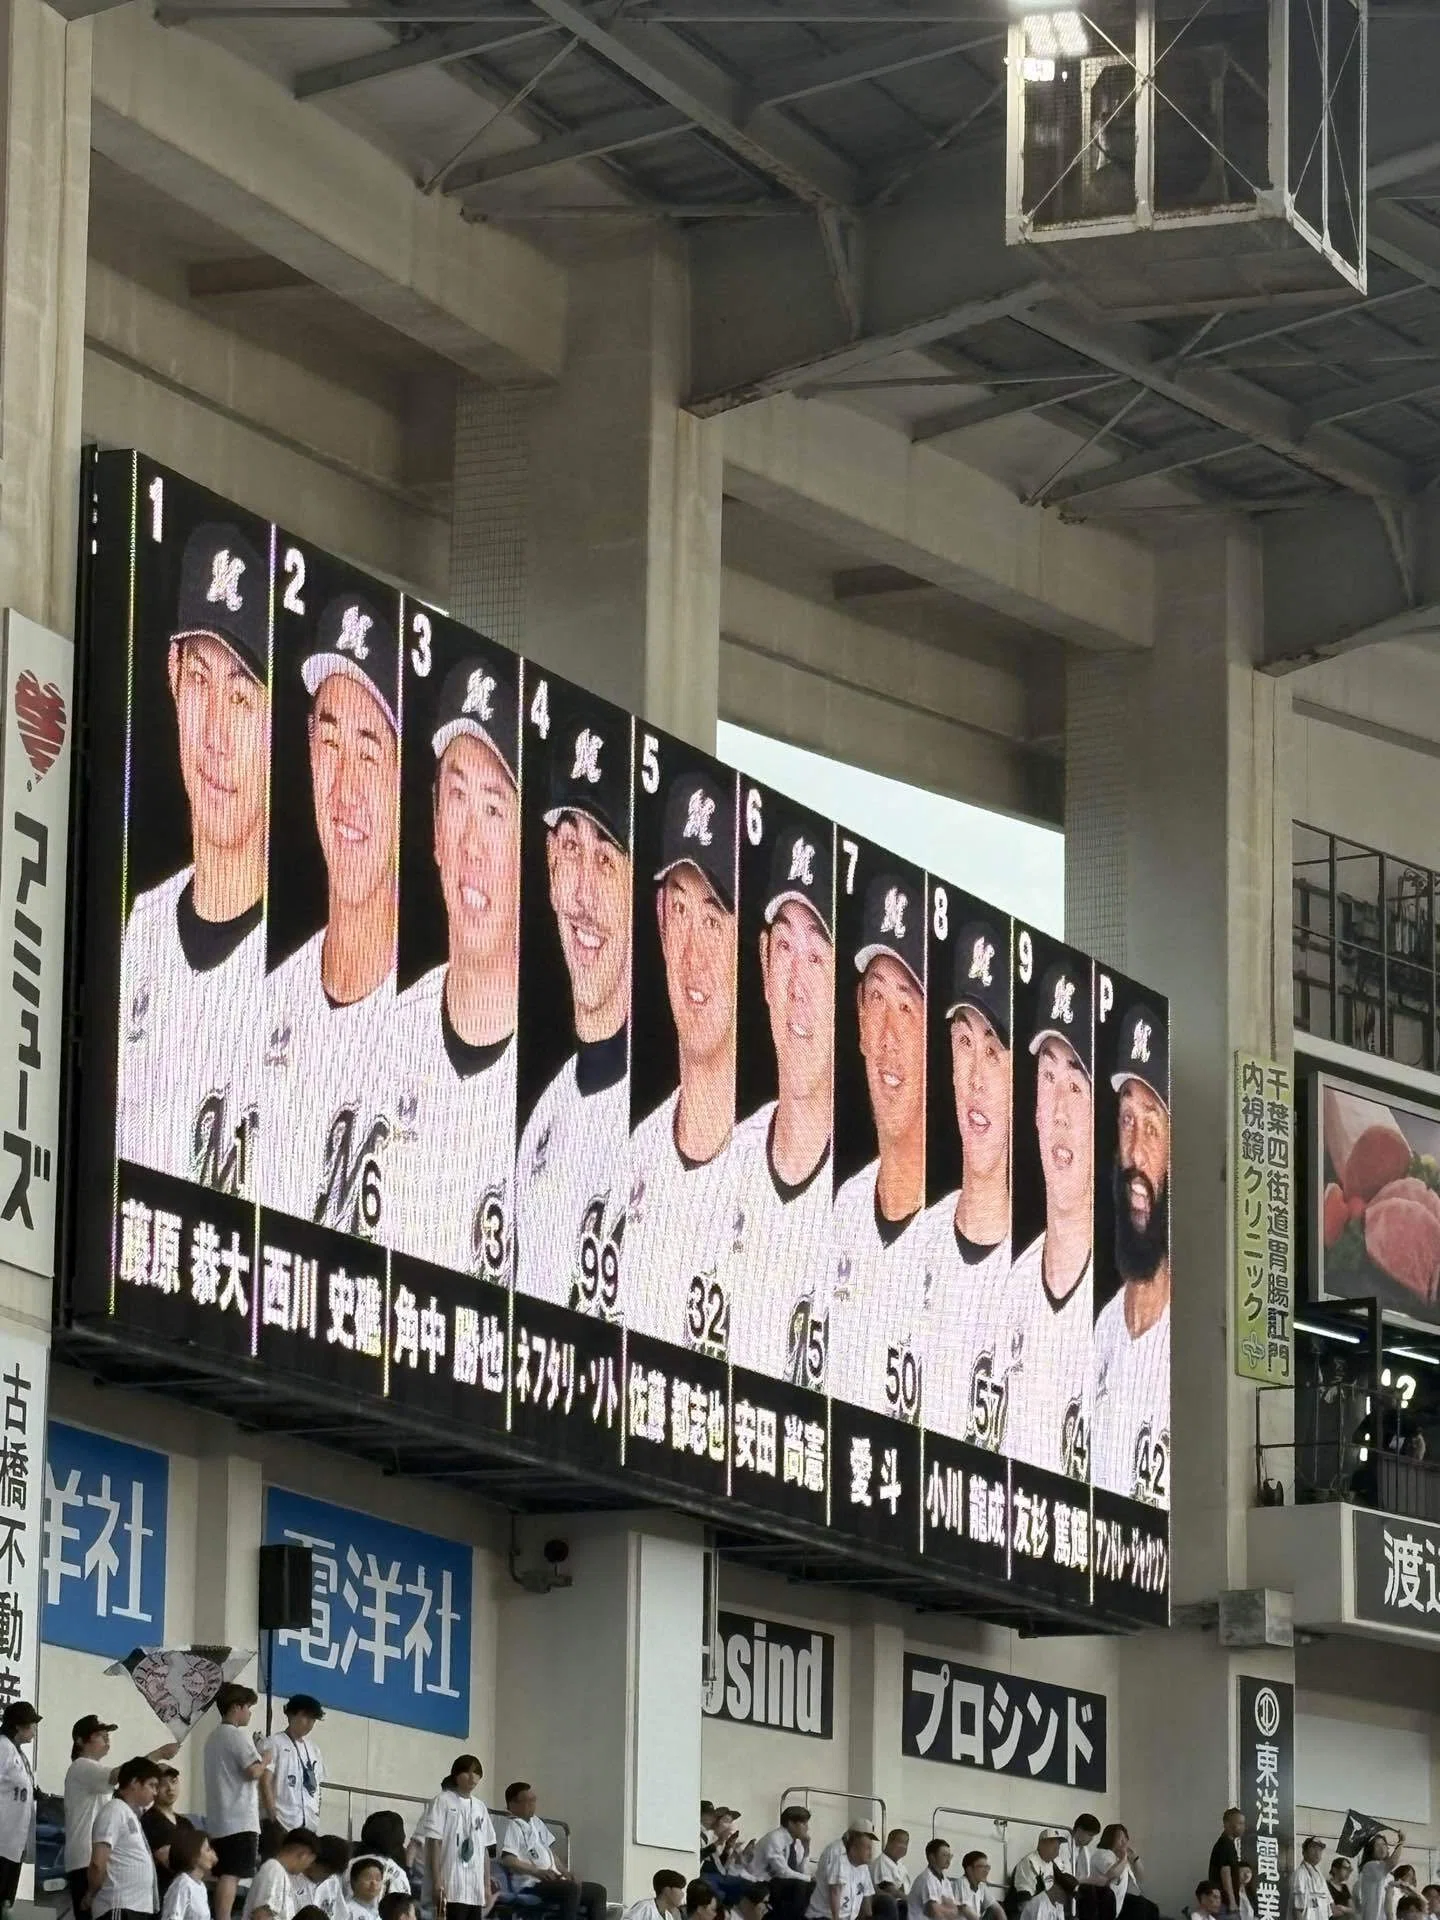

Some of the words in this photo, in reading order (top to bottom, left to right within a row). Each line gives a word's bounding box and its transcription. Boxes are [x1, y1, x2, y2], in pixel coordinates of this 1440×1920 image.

[149, 476, 163, 543] 1
[283, 548, 306, 616] 2
[411, 613, 432, 678] 3
[531, 679, 551, 740] 4
[641, 734, 660, 794] 5
[746, 788, 763, 846] 6
[842, 839, 858, 894] 7
[934, 887, 948, 941] 8
[1018, 931, 1033, 984] 9
[1100, 974, 1114, 1023] P
[361, 1159, 382, 1227] 6
[1242, 1061, 1265, 1322] 内視鏡クリニック
[1266, 1067, 1290, 1377] 千葉四街道胃腸肛門
[484, 1203, 504, 1269] 3
[263, 1245, 319, 1339] 西川
[580, 1236, 618, 1307] 99
[394, 1284, 446, 1374] 角中
[688, 1275, 725, 1344] 32
[808, 1317, 824, 1378] 5
[886, 1346, 917, 1409] 50
[735, 1399, 777, 1477] 安田
[975, 1378, 1004, 1438] 57
[927, 1460, 963, 1535] 小川
[1138, 1438, 1165, 1496] 42
[1013, 1487, 1049, 1558] 友杉
[911, 1664, 1094, 1785] プロシンド
[1255, 1741, 1281, 1920] 東洋電業
